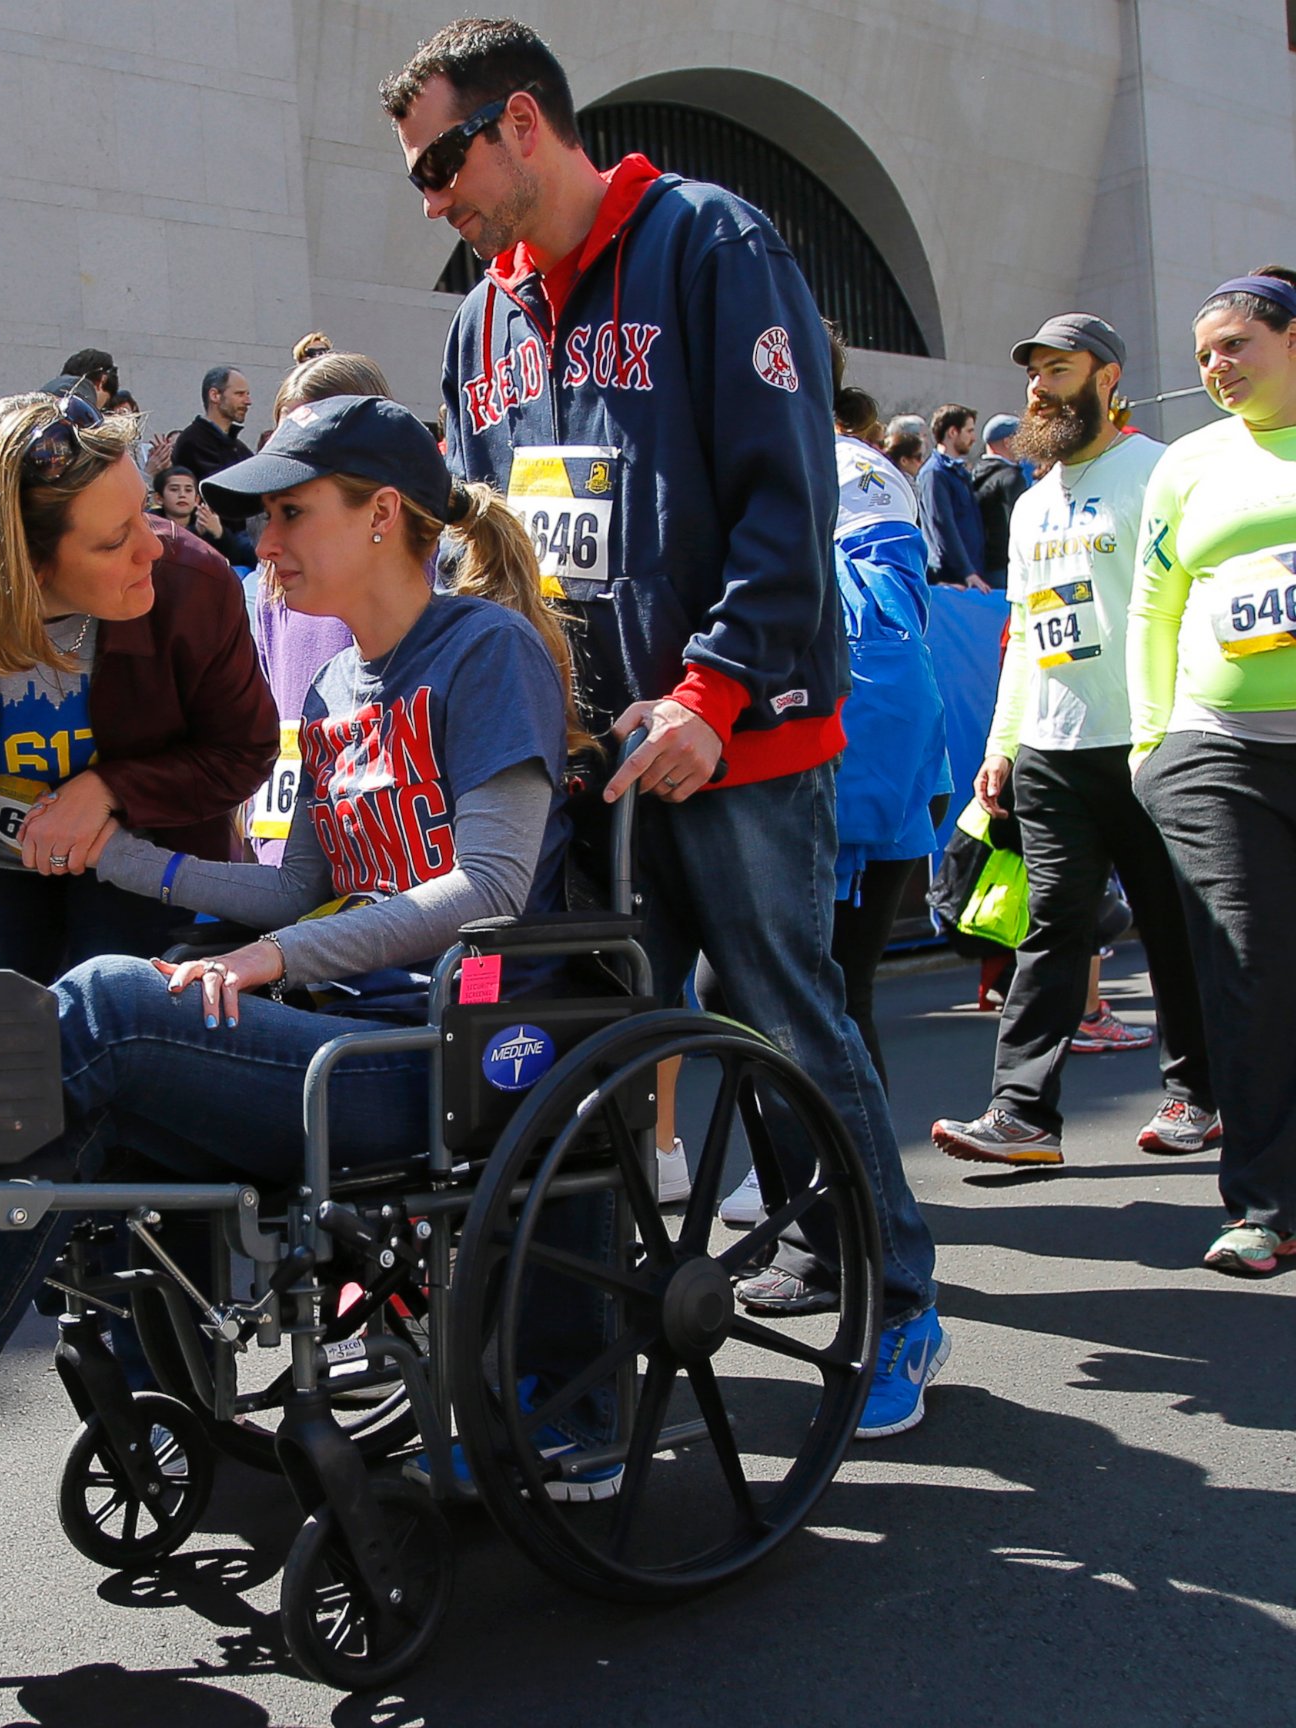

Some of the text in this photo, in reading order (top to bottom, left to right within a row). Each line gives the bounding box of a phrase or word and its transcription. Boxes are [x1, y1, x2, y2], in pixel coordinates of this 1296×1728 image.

[463, 321, 661, 435] RED SOX
[1034, 613, 1081, 651] 164
[491, 1041, 544, 1062] MEDLINE
[338, 1338, 361, 1351] Excel
